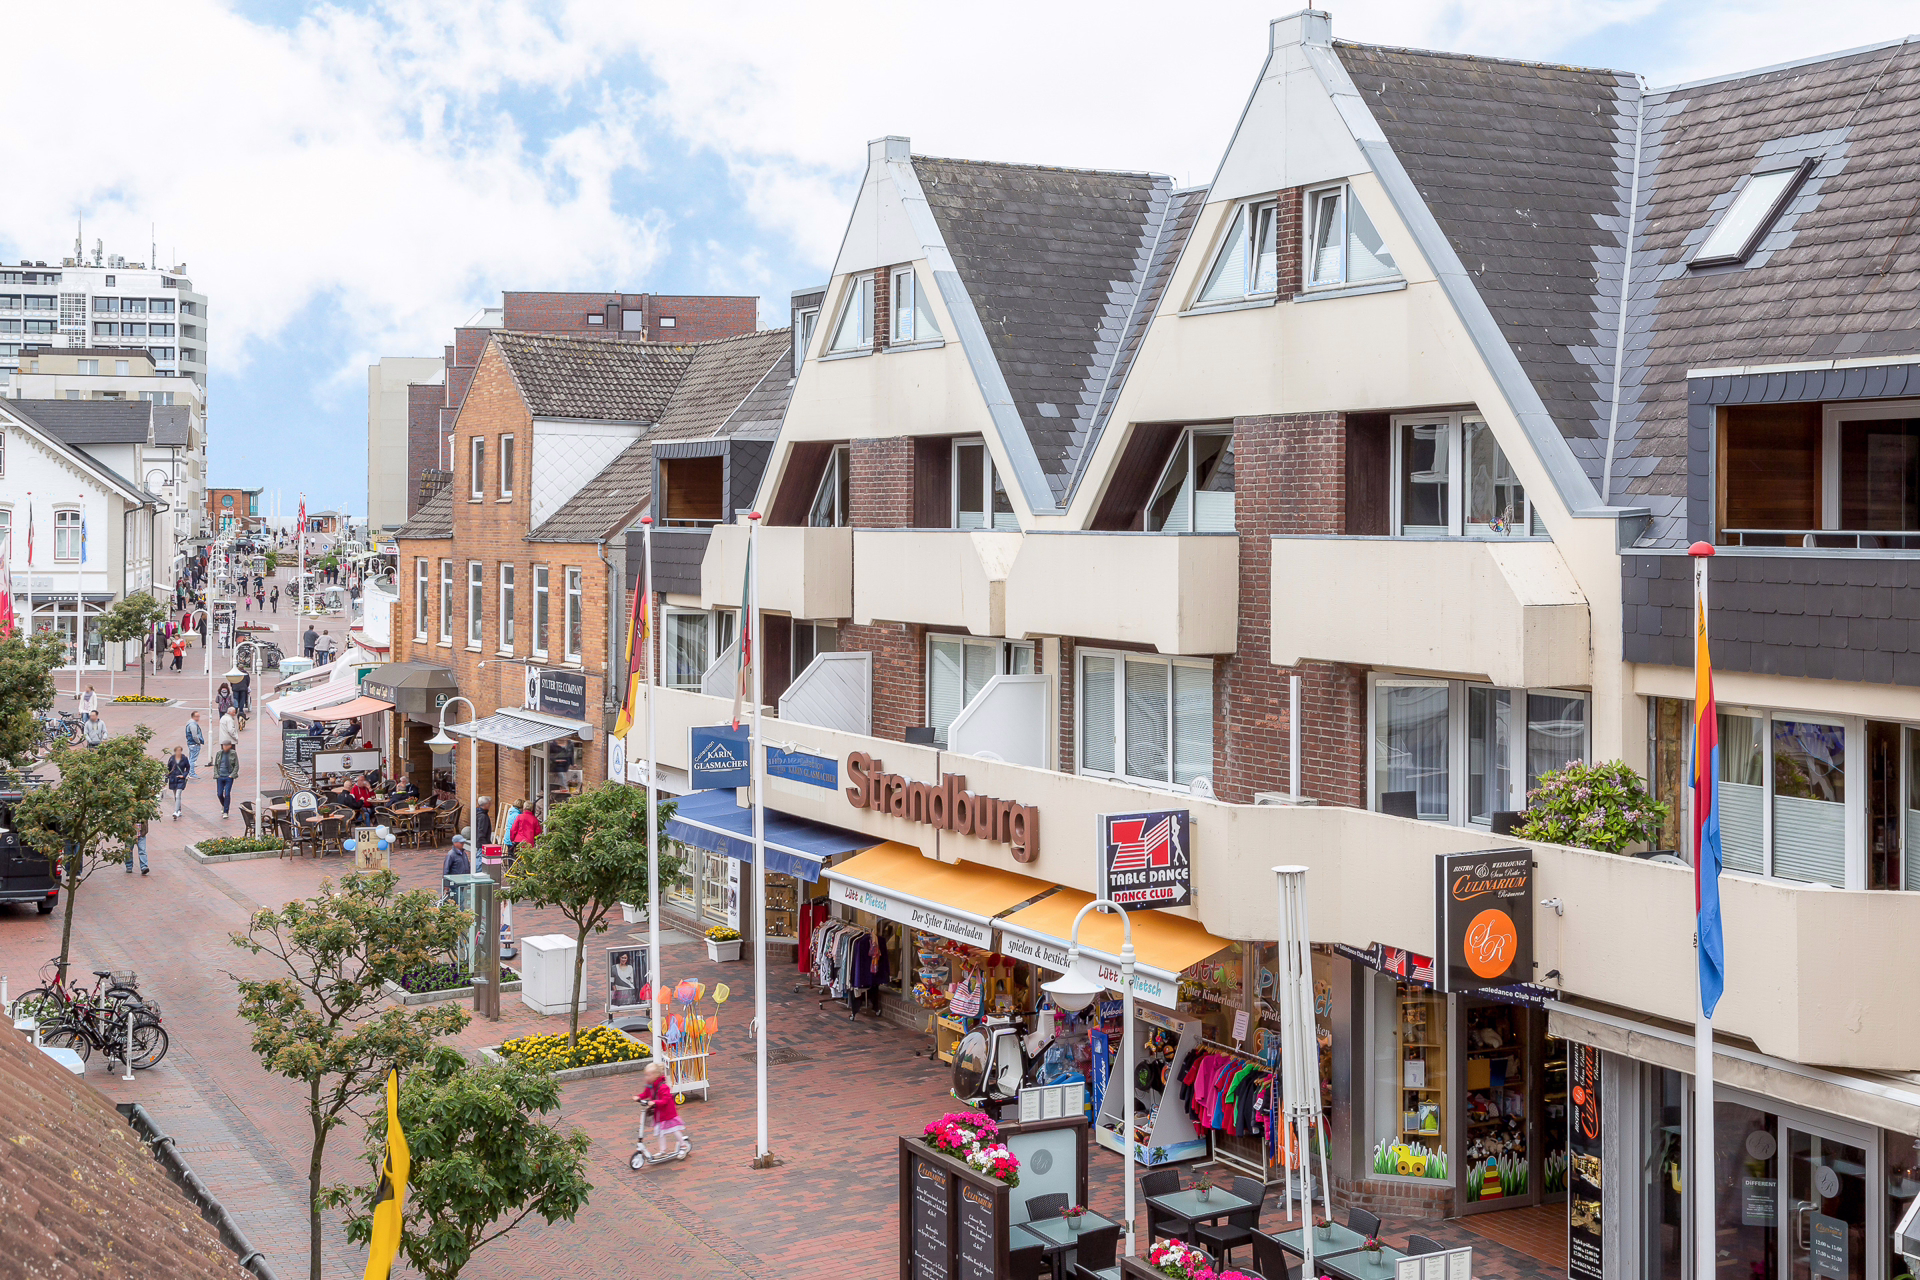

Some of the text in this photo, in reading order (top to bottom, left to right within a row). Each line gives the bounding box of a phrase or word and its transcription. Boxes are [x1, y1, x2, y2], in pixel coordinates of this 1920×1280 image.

[541, 678, 556, 691] SYLTER
[563, 682, 584, 696] COMPANY
[694, 740, 715, 762] Collection
[707, 749, 733, 759] KARIN
[693, 759, 749, 771] GLASMACHER
[788, 765, 837, 785] KARIN GLASMACHER
[845, 750, 1041, 864] Strandburg
[1109, 867, 1189, 887] TABLE DANCE
[1452, 864, 1475, 873] BISTRO
[844, 886, 888, 912] Lütt & Plietsch
[1113, 887, 1174, 903] DANCE CLUB
[911, 909, 984, 942] Der Sylter Kinderladen
[1007, 938, 1071, 969] spielen & besticke
[1098, 964, 1119, 983] Lütt
[1133, 973, 1163, 998] lietsch
[1181, 959, 1239, 991] ütt &
[1181, 982, 1244, 1010] Sylter Kinderladen
[1480, 986, 1514, 998] abledance
[1514, 991, 1530, 1001] Club
[1530, 994, 1542, 1003] auf
